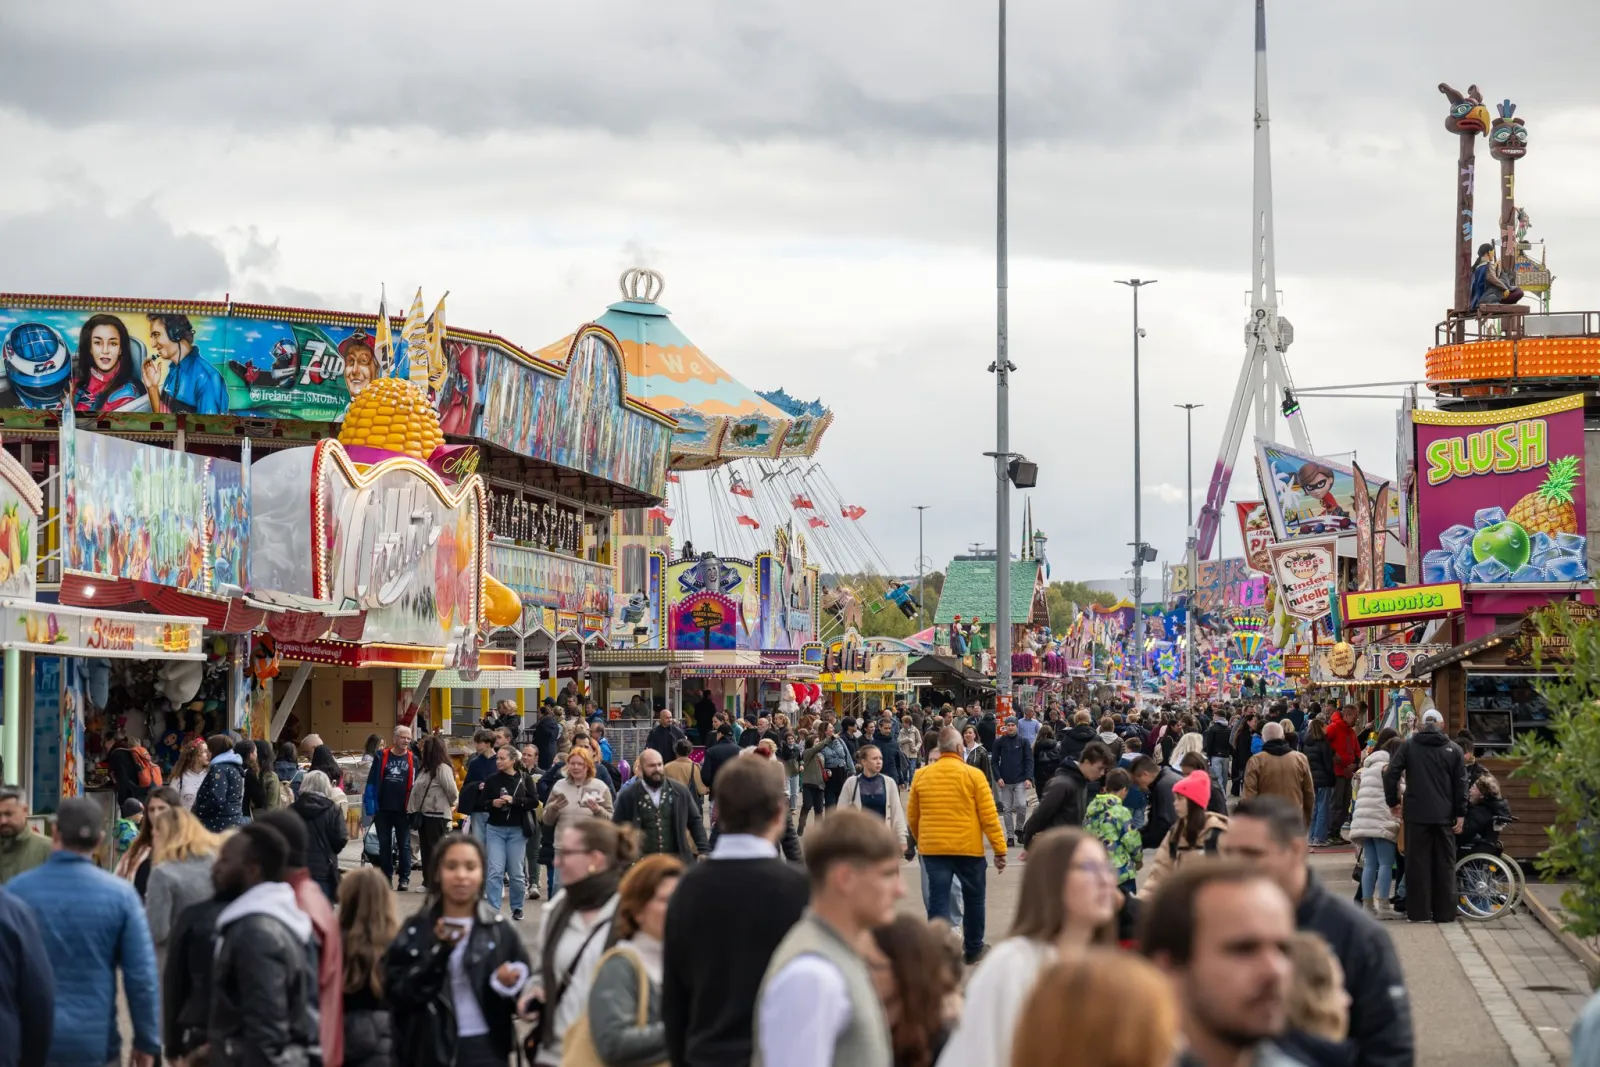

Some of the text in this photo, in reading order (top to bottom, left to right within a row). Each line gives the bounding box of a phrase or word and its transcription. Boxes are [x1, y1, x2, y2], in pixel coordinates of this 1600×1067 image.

[262, 389, 292, 402] Ireland
[1427, 420, 1547, 485] SLUSH
[1289, 587, 1329, 607] nutella
[1358, 592, 1443, 615] Lemontea
